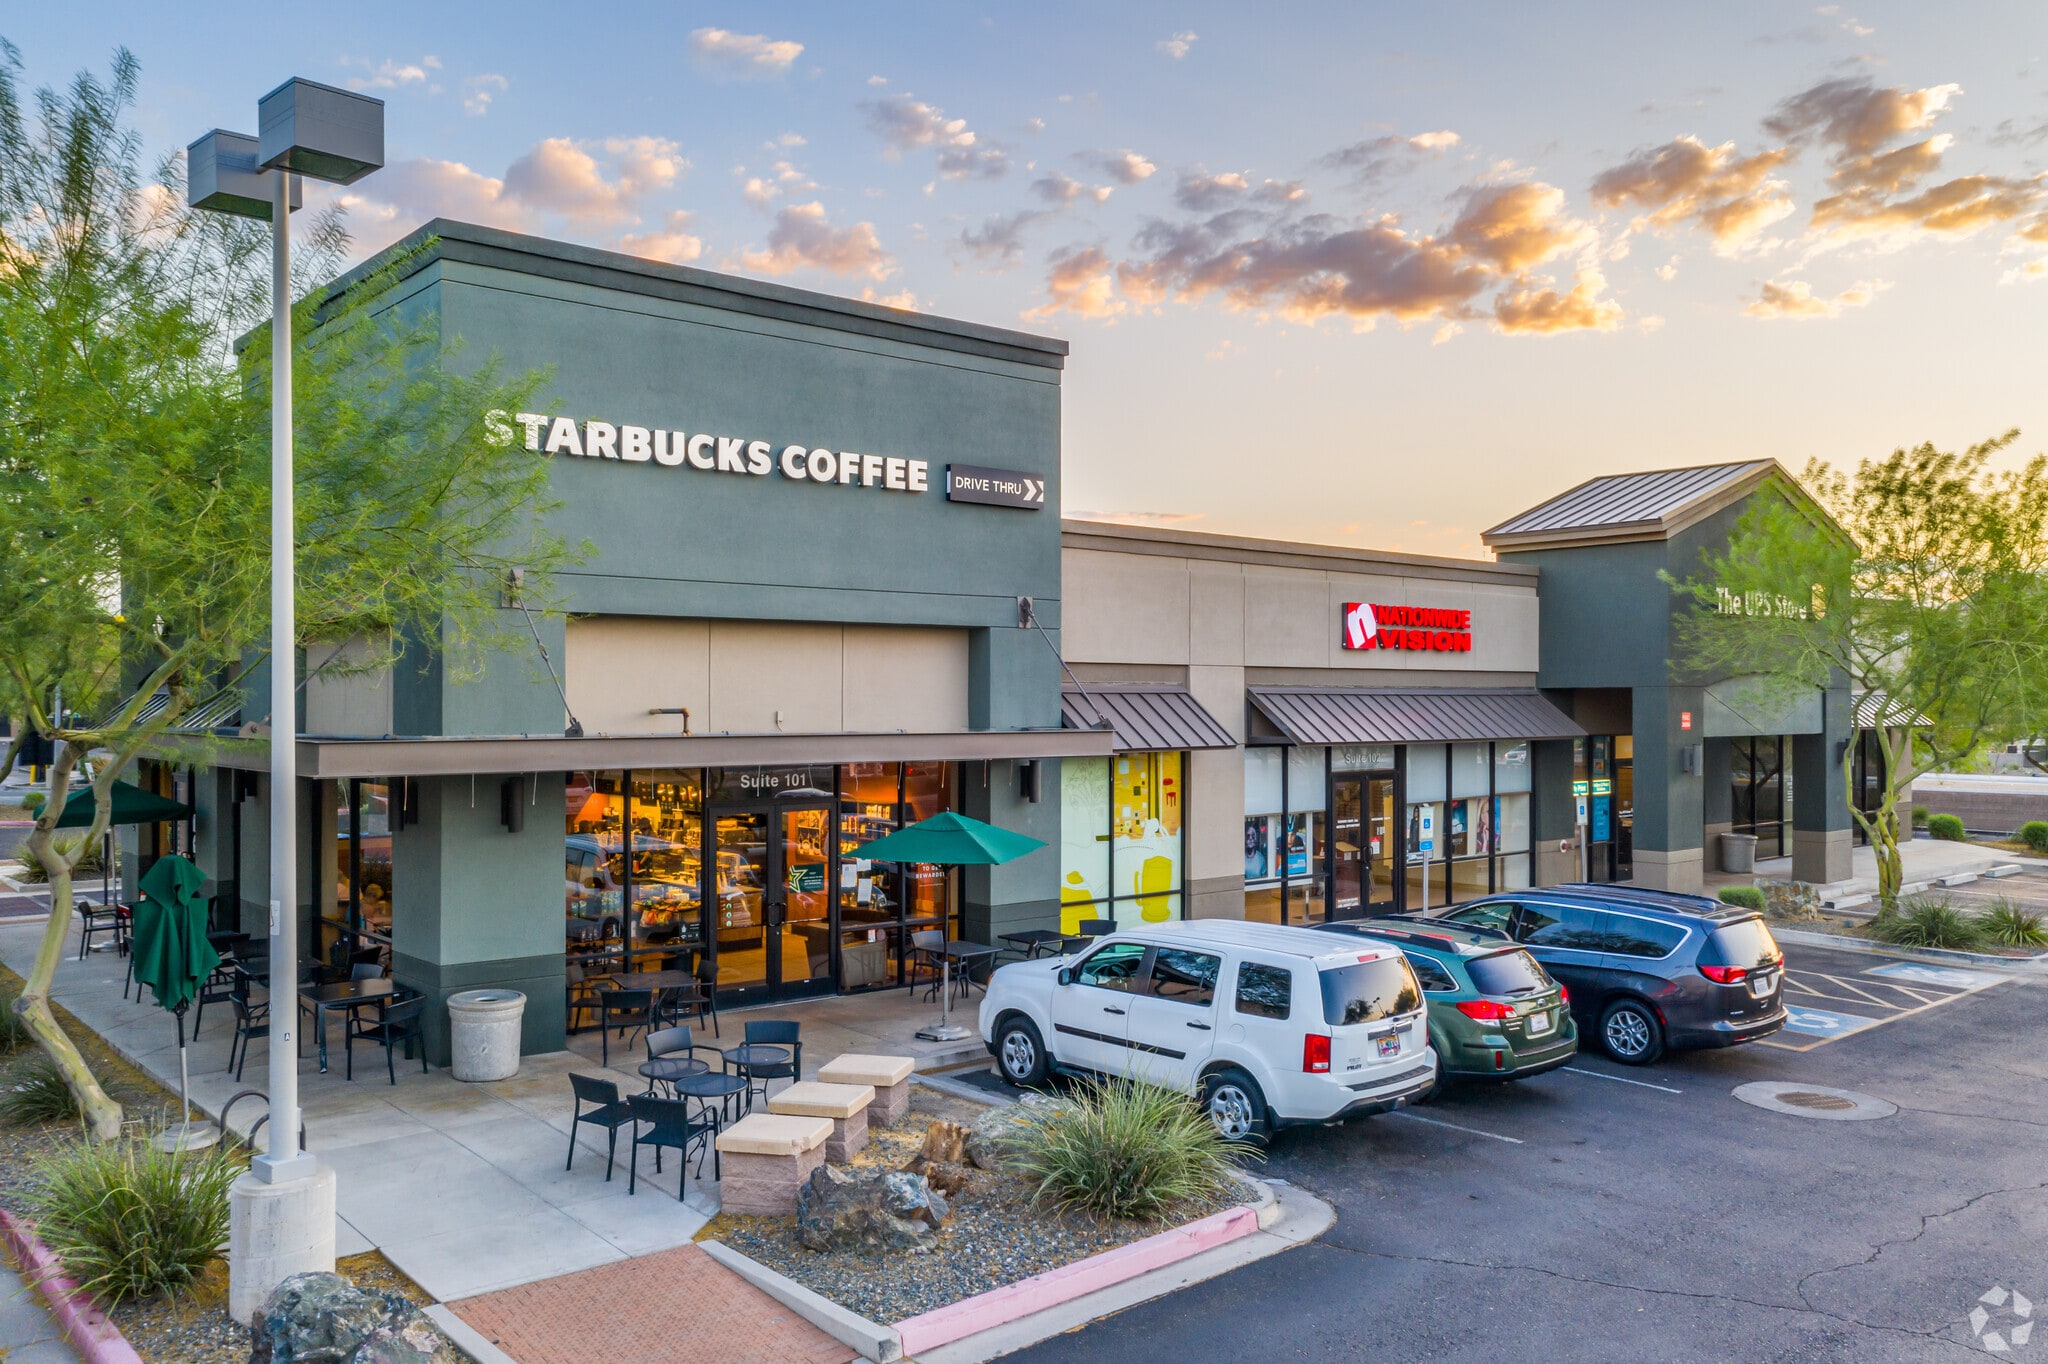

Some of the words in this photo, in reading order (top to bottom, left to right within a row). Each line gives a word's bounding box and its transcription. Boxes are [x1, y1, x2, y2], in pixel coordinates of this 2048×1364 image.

[484, 409, 772, 476] STARBUCKS
[778, 444, 928, 492] COFFEE
[955, 476, 990, 492] DRIVE
[992, 480, 1022, 495] THRU
[1716, 587, 1741, 615] The
[1744, 591, 1772, 616] UPS
[1774, 594, 1807, 619] Store
[1377, 604, 1471, 629] NATIONWIDE
[1376, 628, 1472, 652] VISION
[1345, 753, 1367, 764] Suite
[1368, 753, 1382, 763] 102
[740, 774, 779, 789] Suite
[784, 773, 806, 787] 101
